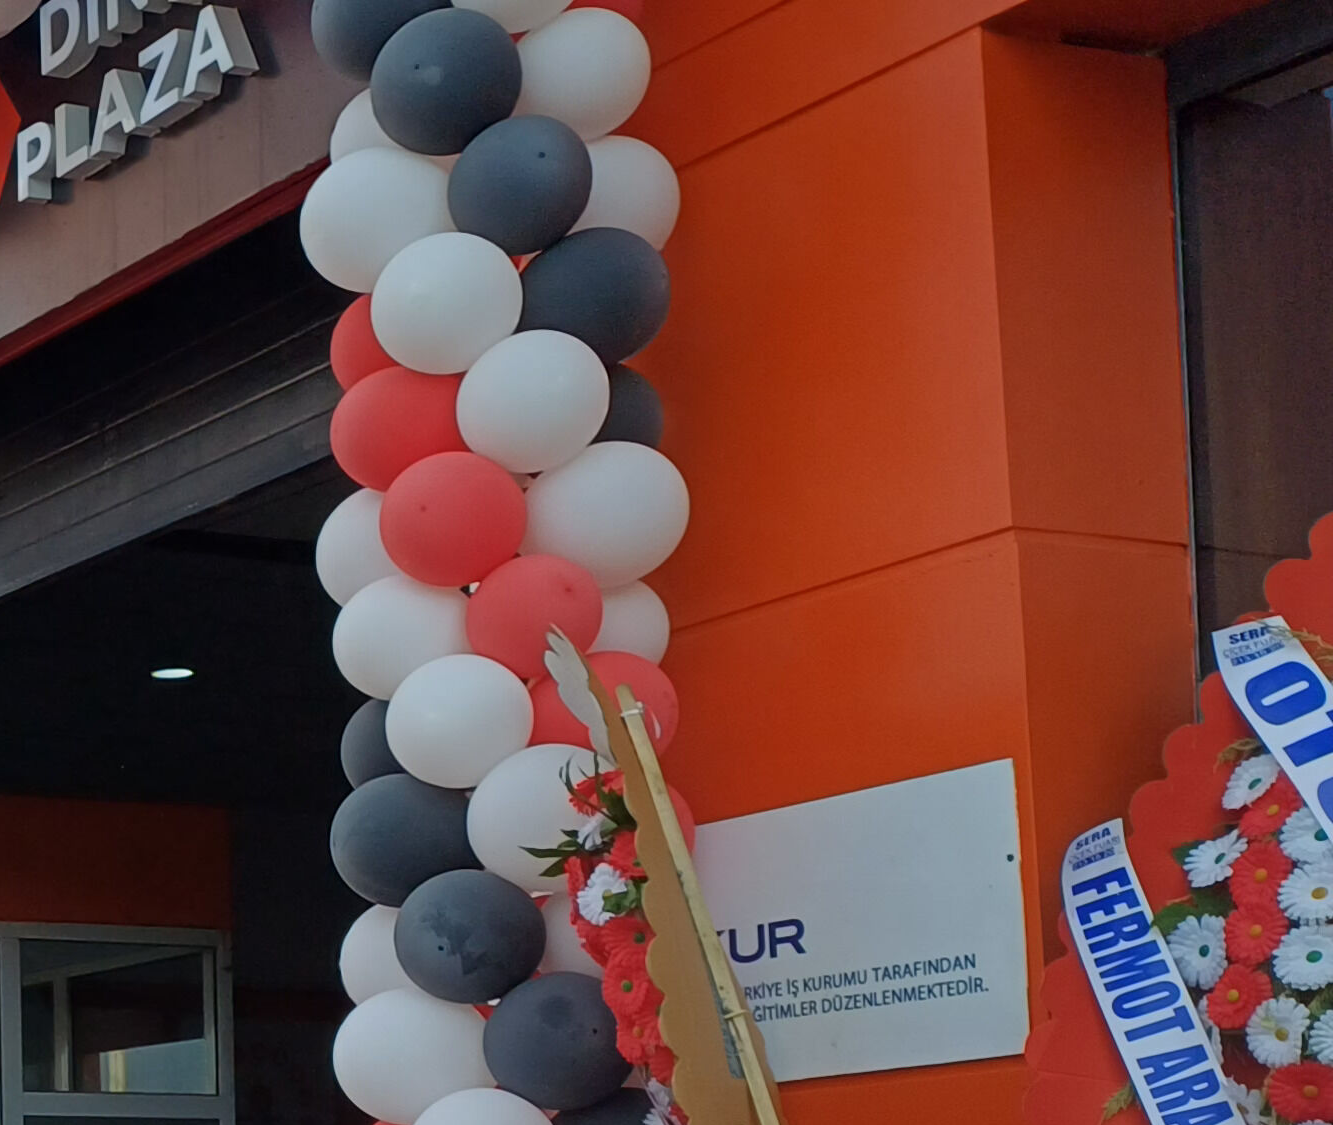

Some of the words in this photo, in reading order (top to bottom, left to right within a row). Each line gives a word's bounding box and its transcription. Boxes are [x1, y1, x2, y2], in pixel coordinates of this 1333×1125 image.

[17, 4, 241, 204] PLAZA
[744, 980, 784, 1001] RKİYE
[786, 977, 800, 998] İŞ
[803, 969, 868, 993] KURUMU
[871, 953, 977, 982] TARAFINDAN
[1072, 866, 1196, 1043] FERMOT
[753, 1000, 818, 1023] ĞİTİMLER
